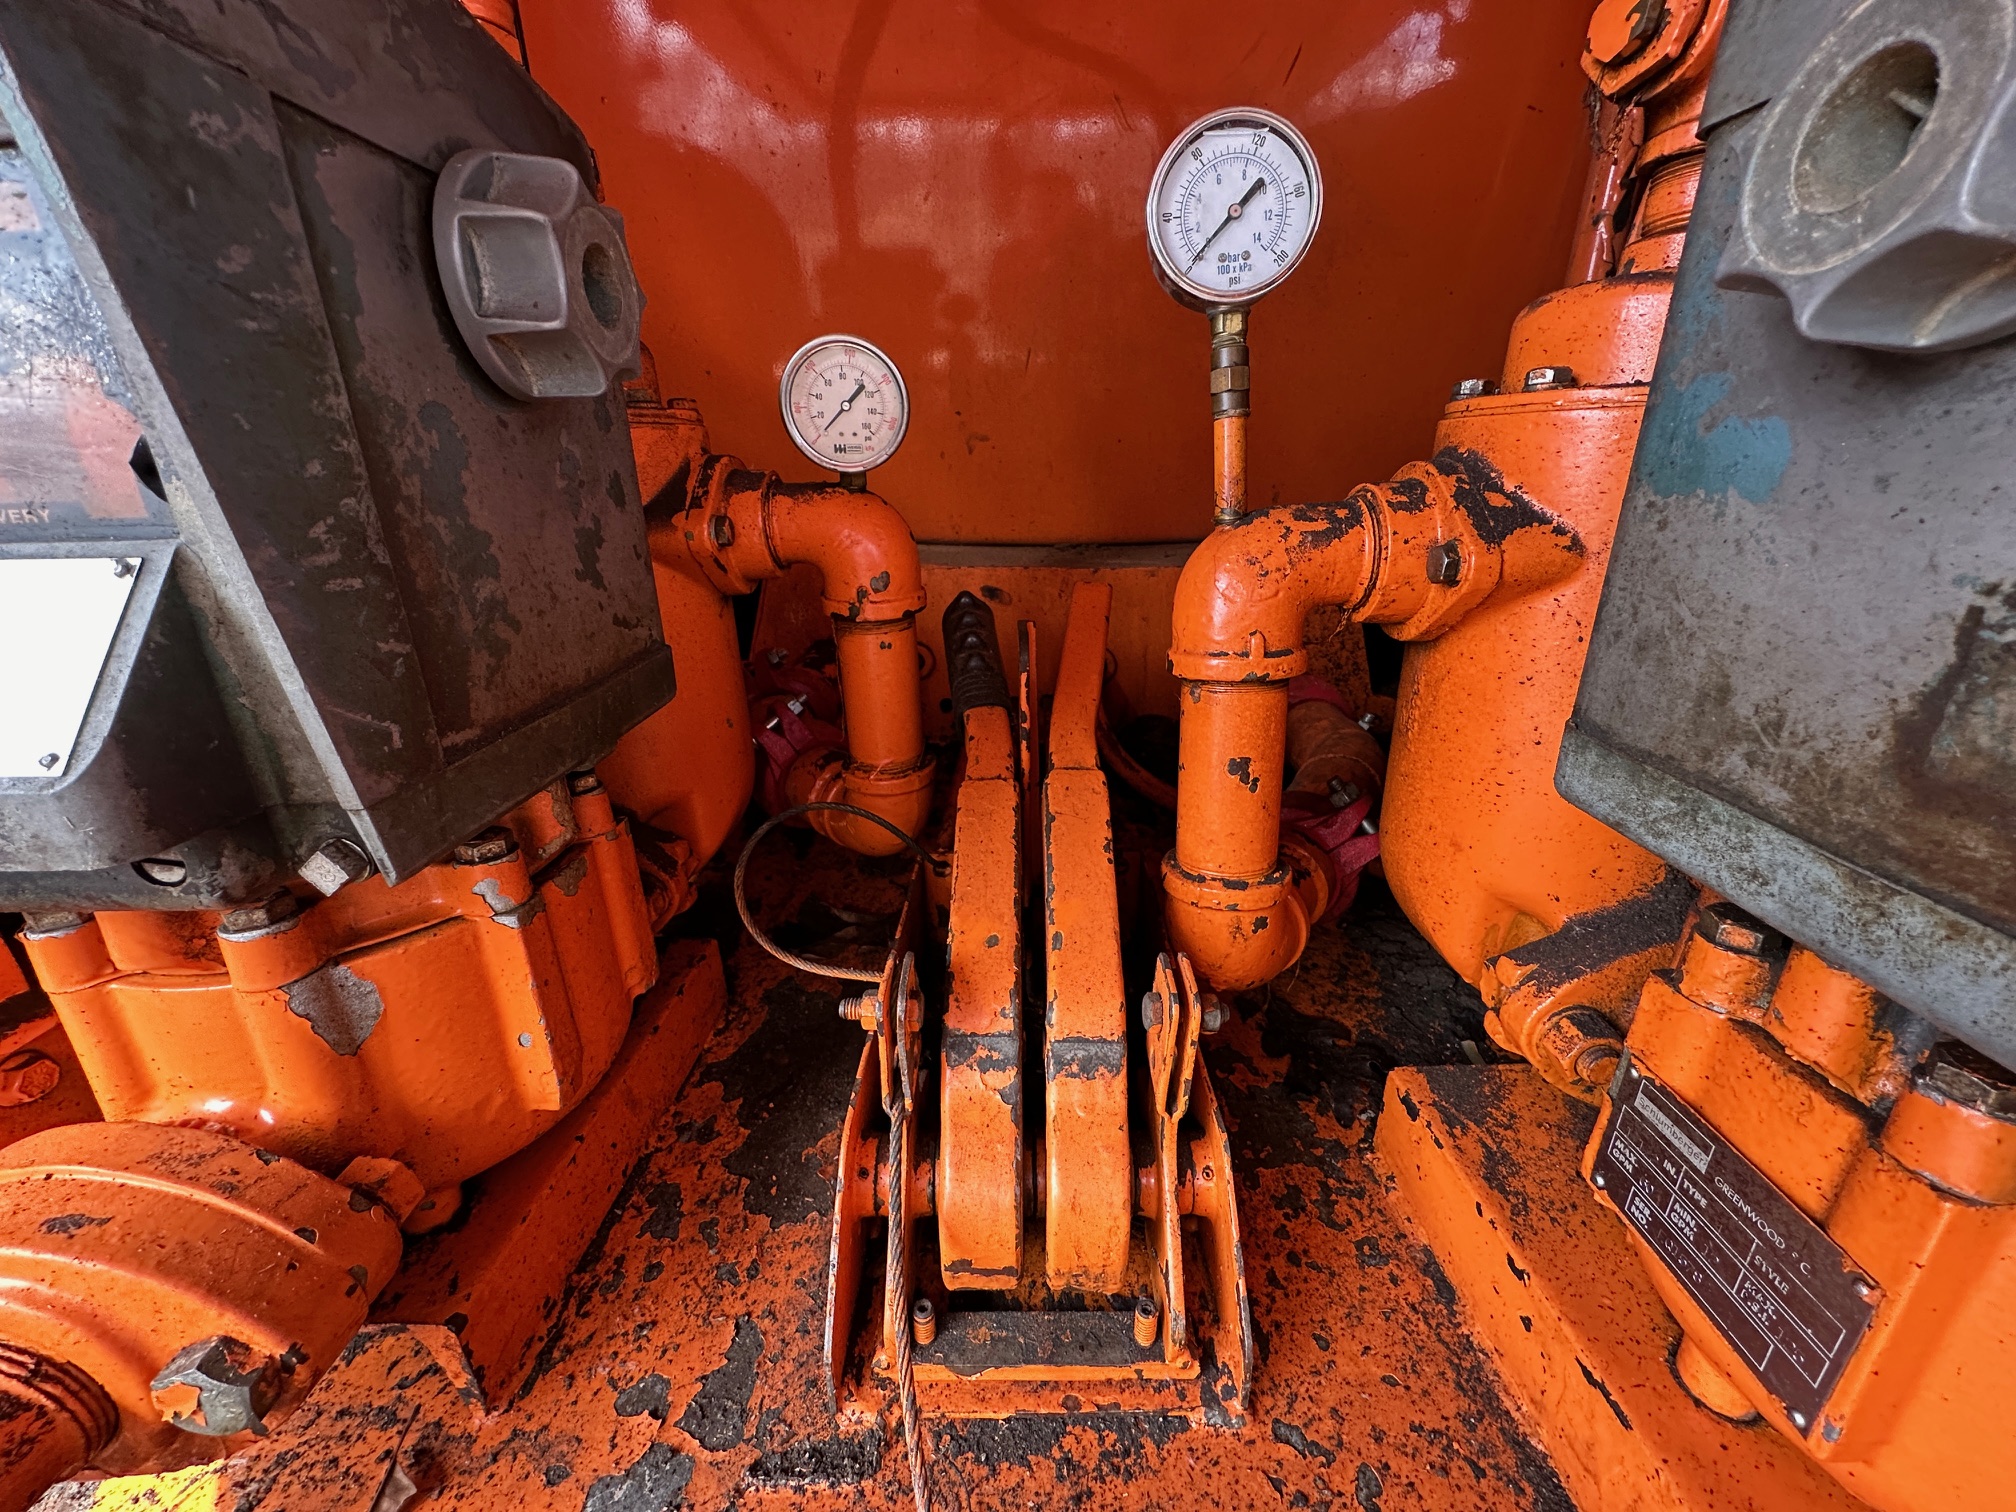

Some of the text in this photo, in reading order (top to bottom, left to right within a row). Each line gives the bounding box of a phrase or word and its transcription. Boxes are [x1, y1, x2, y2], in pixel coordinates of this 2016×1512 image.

[1252, 133, 1266, 147] 120
[1191, 147, 1203, 160] 80
[1216, 173, 1222, 185] 6
[1242, 169, 1247, 181] 8
[1293, 181, 1305, 198] 160
[1162, 212, 1172, 223] 40
[1264, 210, 1273, 221] 12
[1196, 222, 1201, 233] 2
[1253, 232, 1261, 243] 14
[1228, 253, 1240, 262] bar
[1274, 249, 1289, 267] 200
[1217, 262, 1252, 275] 100 x kPa
[1229, 274, 1241, 287] psi
[815, 393, 823, 401] 40
[817, 411, 824, 419] 20
[1637, 1095, 1705, 1167] Schlumberger
[1611, 1146, 1633, 1173] GPM
[1614, 1138, 1639, 1167] MAX.
[1662, 1158, 1678, 1180] IN.
[1681, 1178, 1707, 1209] TYPE
[1630, 1203, 1649, 1229] NO.
[1633, 1195, 1653, 1222] SER.
[1673, 1200, 1698, 1232] MIN.
[1713, 1174, 1786, 1251] GREENWOOD
[1669, 1209, 1695, 1241] GPM
[1753, 1253, 1789, 1296] STYLE
